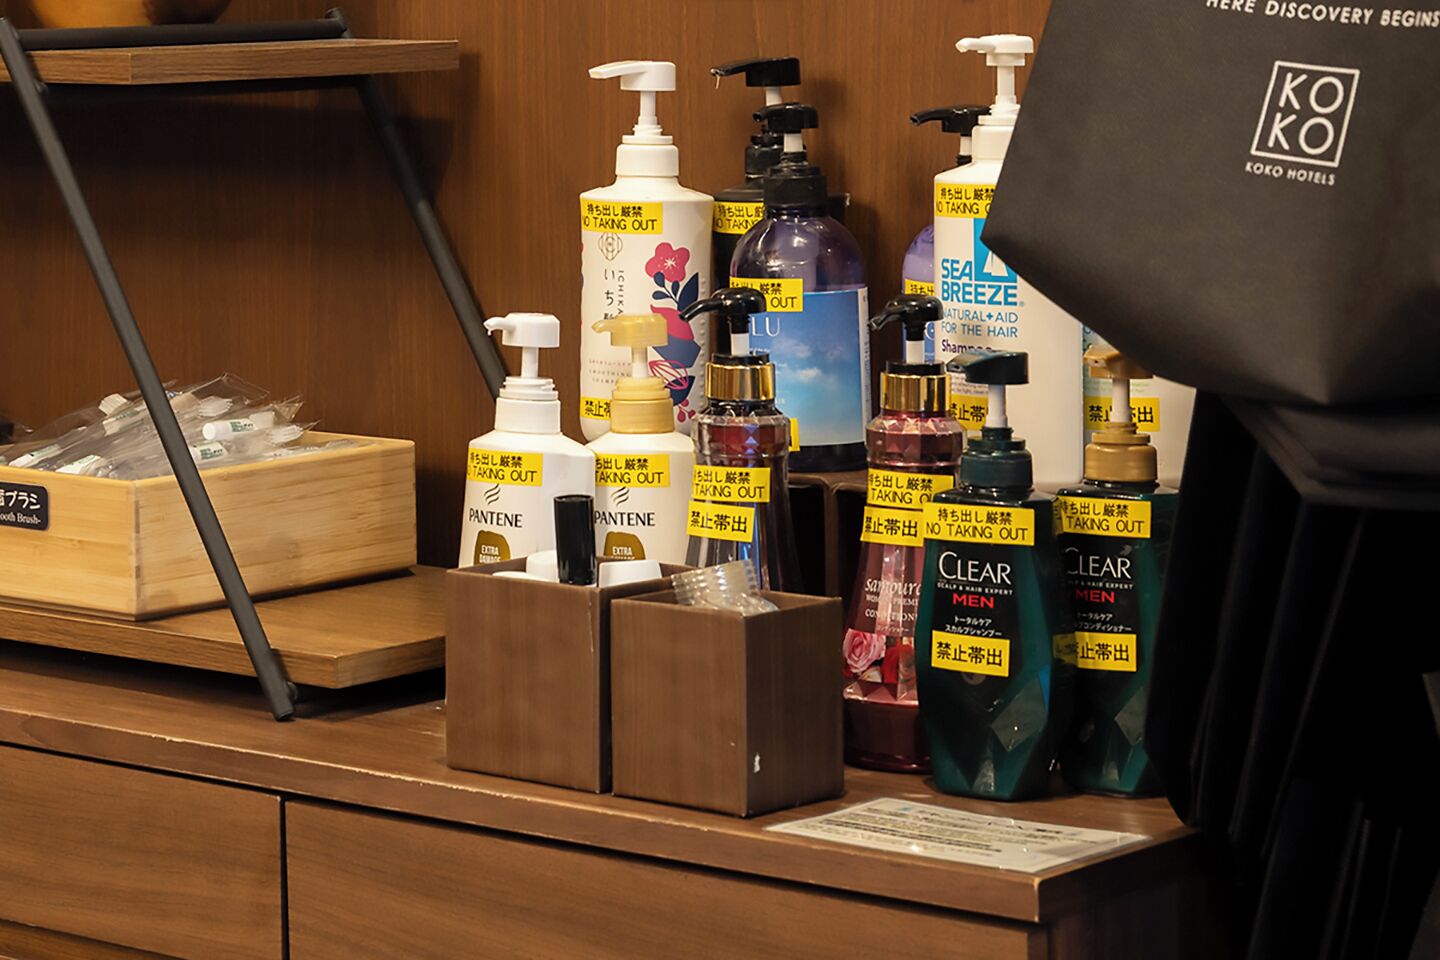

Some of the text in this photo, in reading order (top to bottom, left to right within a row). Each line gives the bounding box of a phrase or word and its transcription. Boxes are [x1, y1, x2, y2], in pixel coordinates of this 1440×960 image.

[1265, 0, 1373, 25] DISCOVERY
[1279, 72, 1344, 115] KO
[1267, 112, 1335, 155] KO
[1245, 161, 1336, 186] KOKO HOTELS
[945, 202, 980, 214] TAKING
[593, 218, 626, 229] TAKING
[631, 218, 658, 230] OUT
[941, 258, 973, 281] SEA
[941, 281, 1018, 306] BREEZE
[770, 297, 797, 308] OUT
[941, 323, 1018, 338] FOR THE HAIR
[473, 467, 537, 482] TAKING OUT
[637, 471, 664, 484] OUT
[695, 483, 765, 498] TAKING OUT
[871, 487, 912, 504] TAKING
[469, 508, 523, 528] PANTENE
[595, 510, 655, 526] PANTENE
[690, 510, 748, 533] 禁止帯出
[938, 507, 1013, 525] 持ち出し厳禁
[1066, 516, 1144, 533] TAKING OUT
[865, 516, 918, 538] 禁止帯出
[926, 522, 1028, 541] NO TAKING OUT
[481, 544, 499, 556] EXTRA
[612, 546, 632, 556] EXTRA
[939, 551, 1012, 584] CLEAR
[1065, 547, 1131, 579] CLEAR
[966, 585, 982, 593] HAIR
[985, 587, 1013, 595] EXPERT
[1105, 582, 1134, 590] EXPERT
[952, 593, 994, 609] MEN
[1075, 589, 1115, 604] MEN
[954, 615, 992, 627] トータルケア
[936, 640, 1003, 667] 禁止帯出
[1076, 641, 1129, 662] 止帯出
